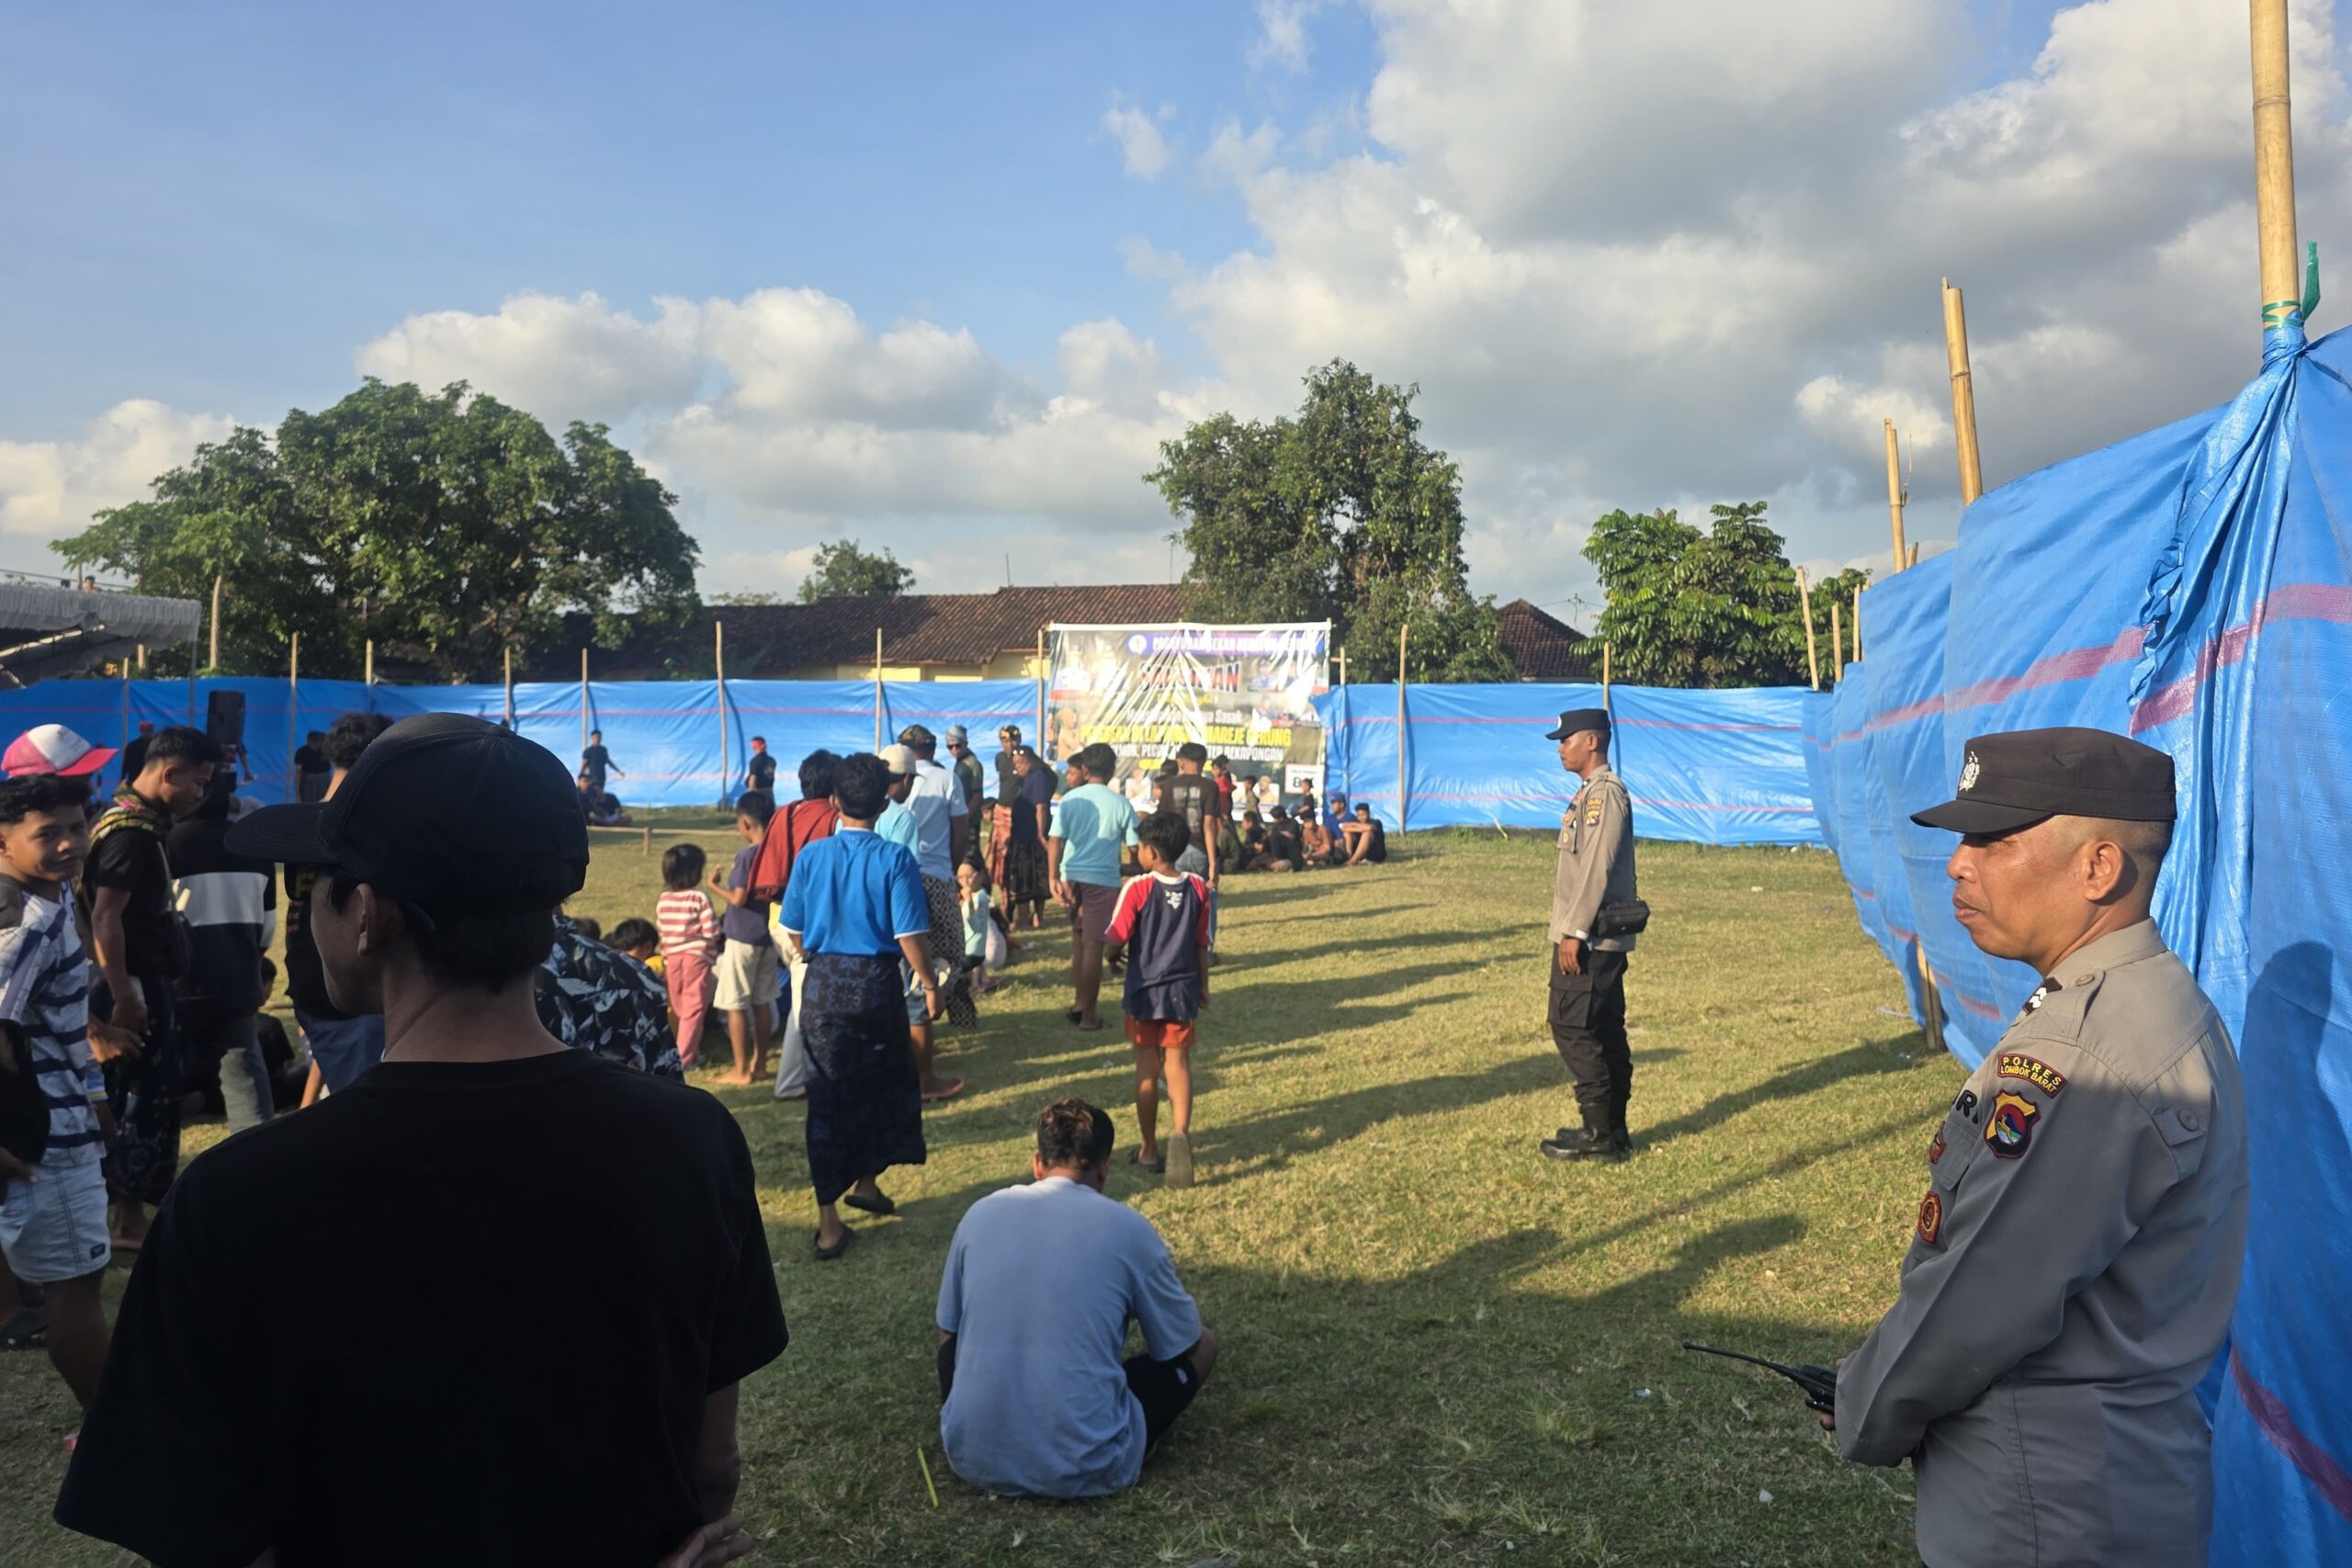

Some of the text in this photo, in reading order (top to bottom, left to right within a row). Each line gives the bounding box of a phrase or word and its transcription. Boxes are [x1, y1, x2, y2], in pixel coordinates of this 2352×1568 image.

[2000, 1066, 2058, 1093] LOMBOK BARAT
[2002, 1056, 2063, 1087] POLRES
